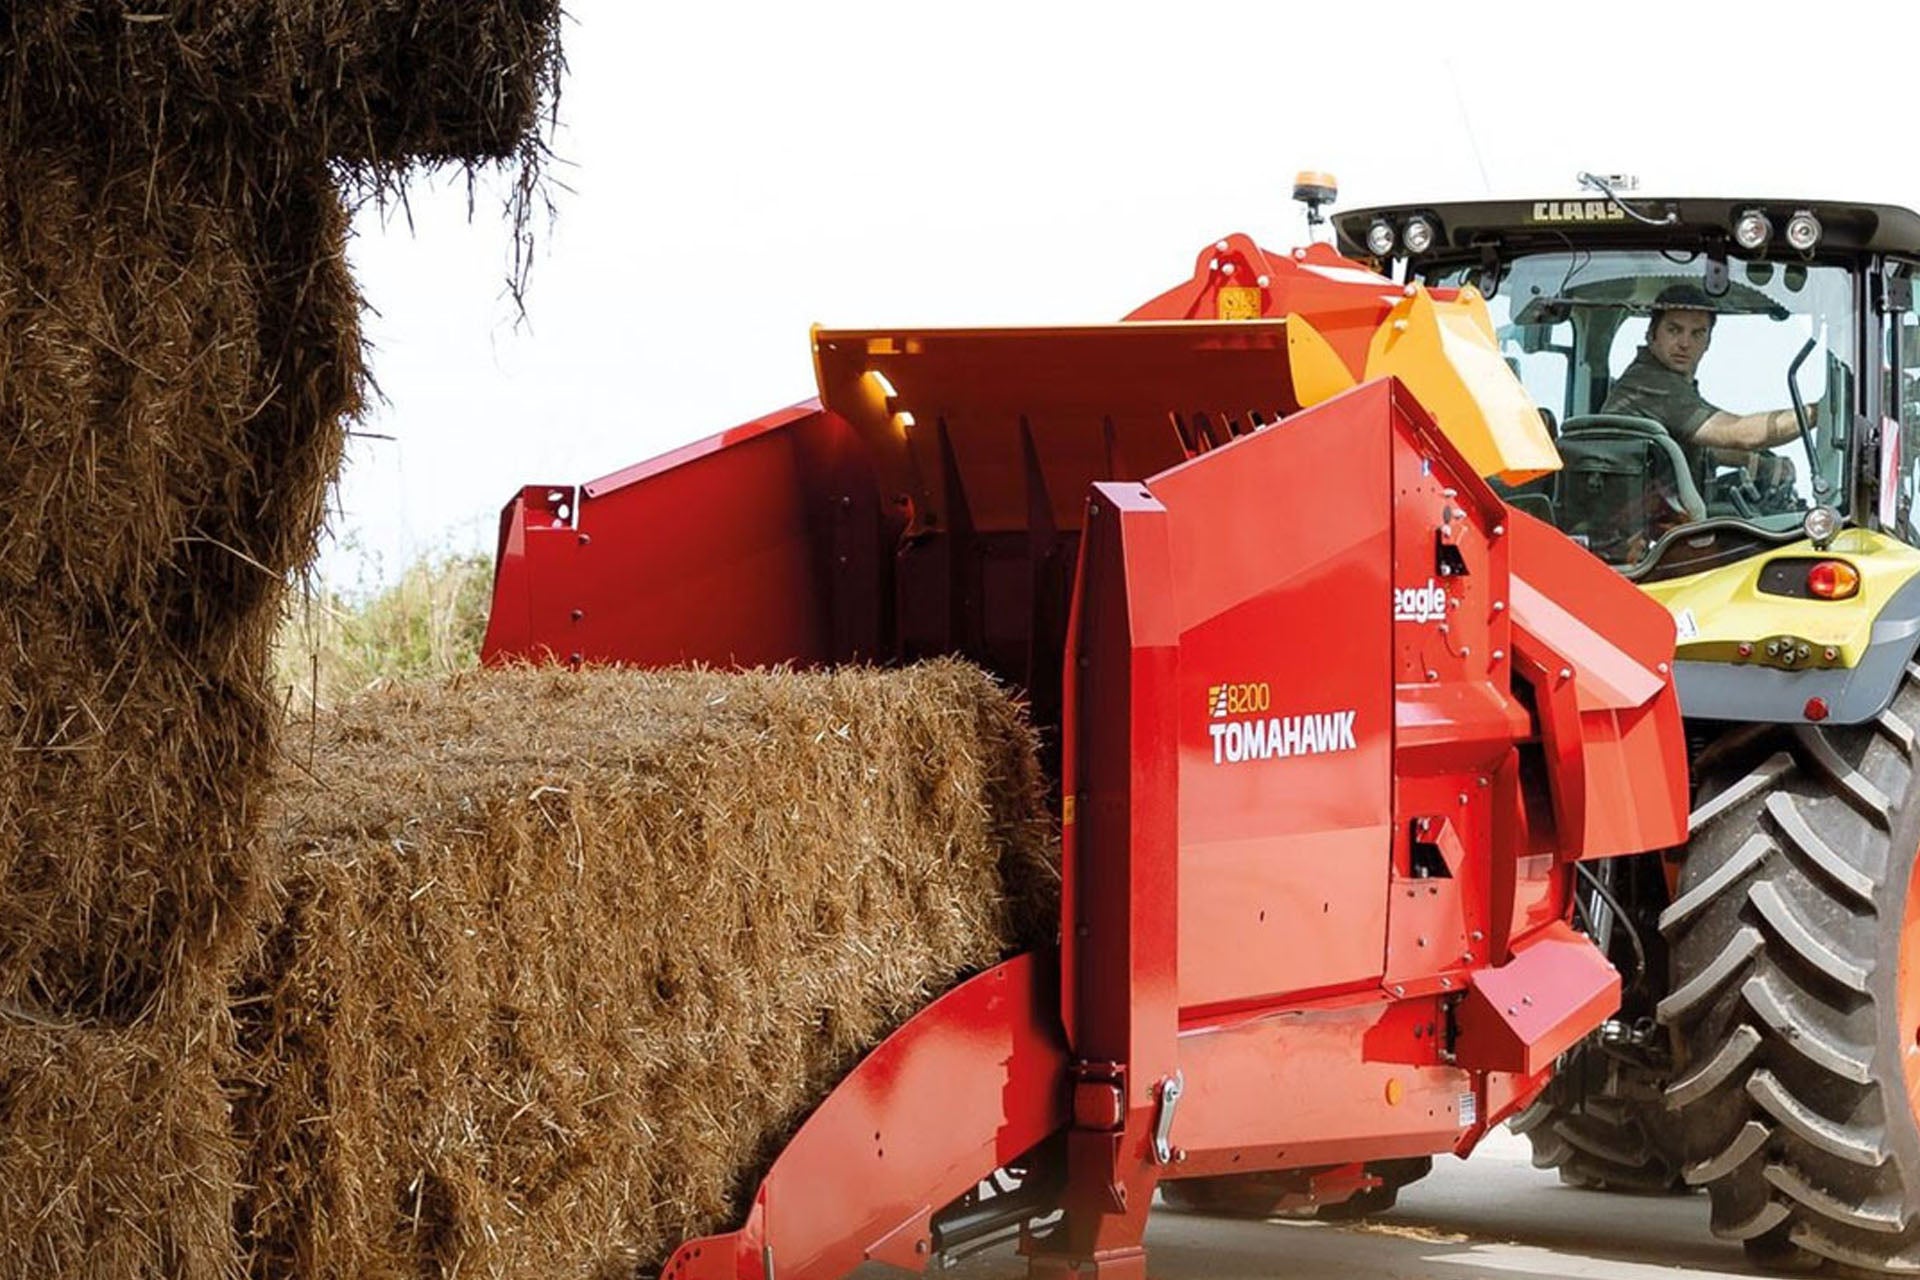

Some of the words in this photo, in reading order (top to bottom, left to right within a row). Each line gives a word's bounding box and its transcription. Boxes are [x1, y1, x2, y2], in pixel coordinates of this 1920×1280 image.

[1533, 202, 1625, 221] CLAAS
[1228, 683, 1269, 713] 8200
[1209, 710, 1357, 765] TOMAHAWK
